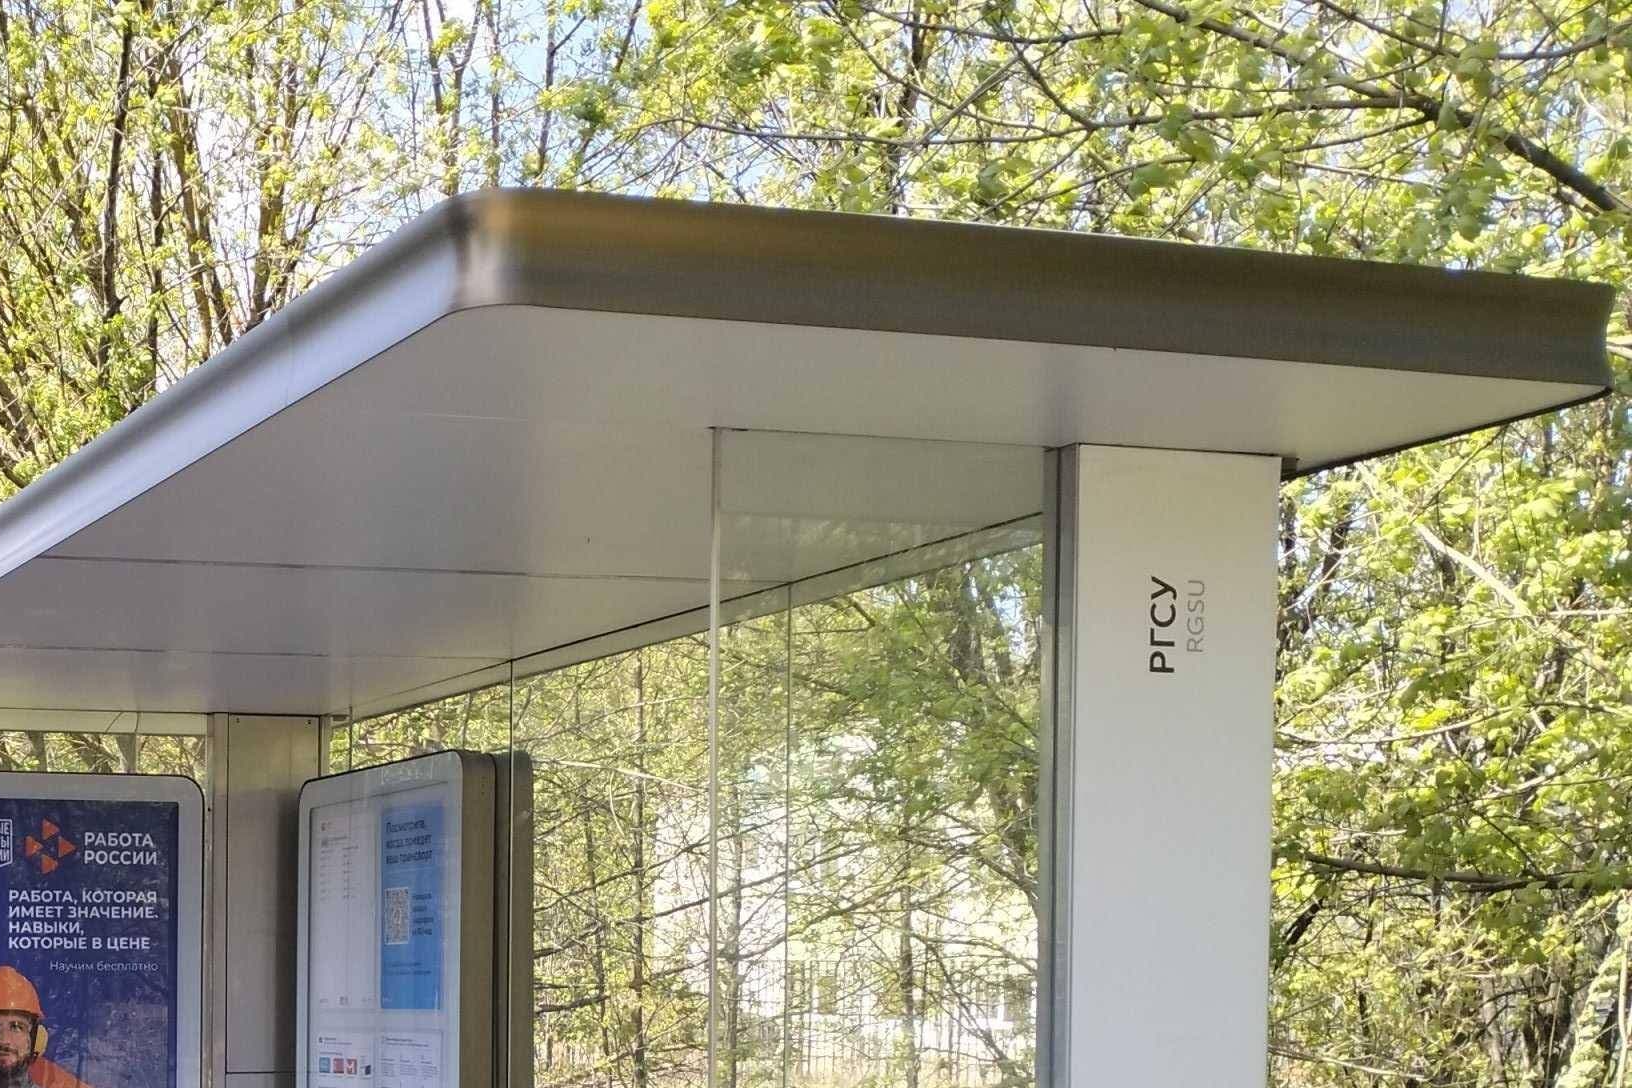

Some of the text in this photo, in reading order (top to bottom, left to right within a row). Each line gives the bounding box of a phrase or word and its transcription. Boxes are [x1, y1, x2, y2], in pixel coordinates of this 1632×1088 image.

[1149, 575, 1177, 673] РГСУ
[1186, 579, 1205, 653] RGSU
[83, 831, 155, 847] РАБОТА
[83, 850, 158, 865] РОССИИ
[8, 889, 157, 905] РАБОТА, КОТОРАЯ
[8, 905, 159, 919] ИМЕЕТ ЗНАЧЕНИЕ.
[8, 921, 85, 936] НАВЫКИ,
[8, 936, 151, 952] КОТОРЫЕ В ЦЕНЕ
[49, 960, 160, 974] Научим бесплатно
